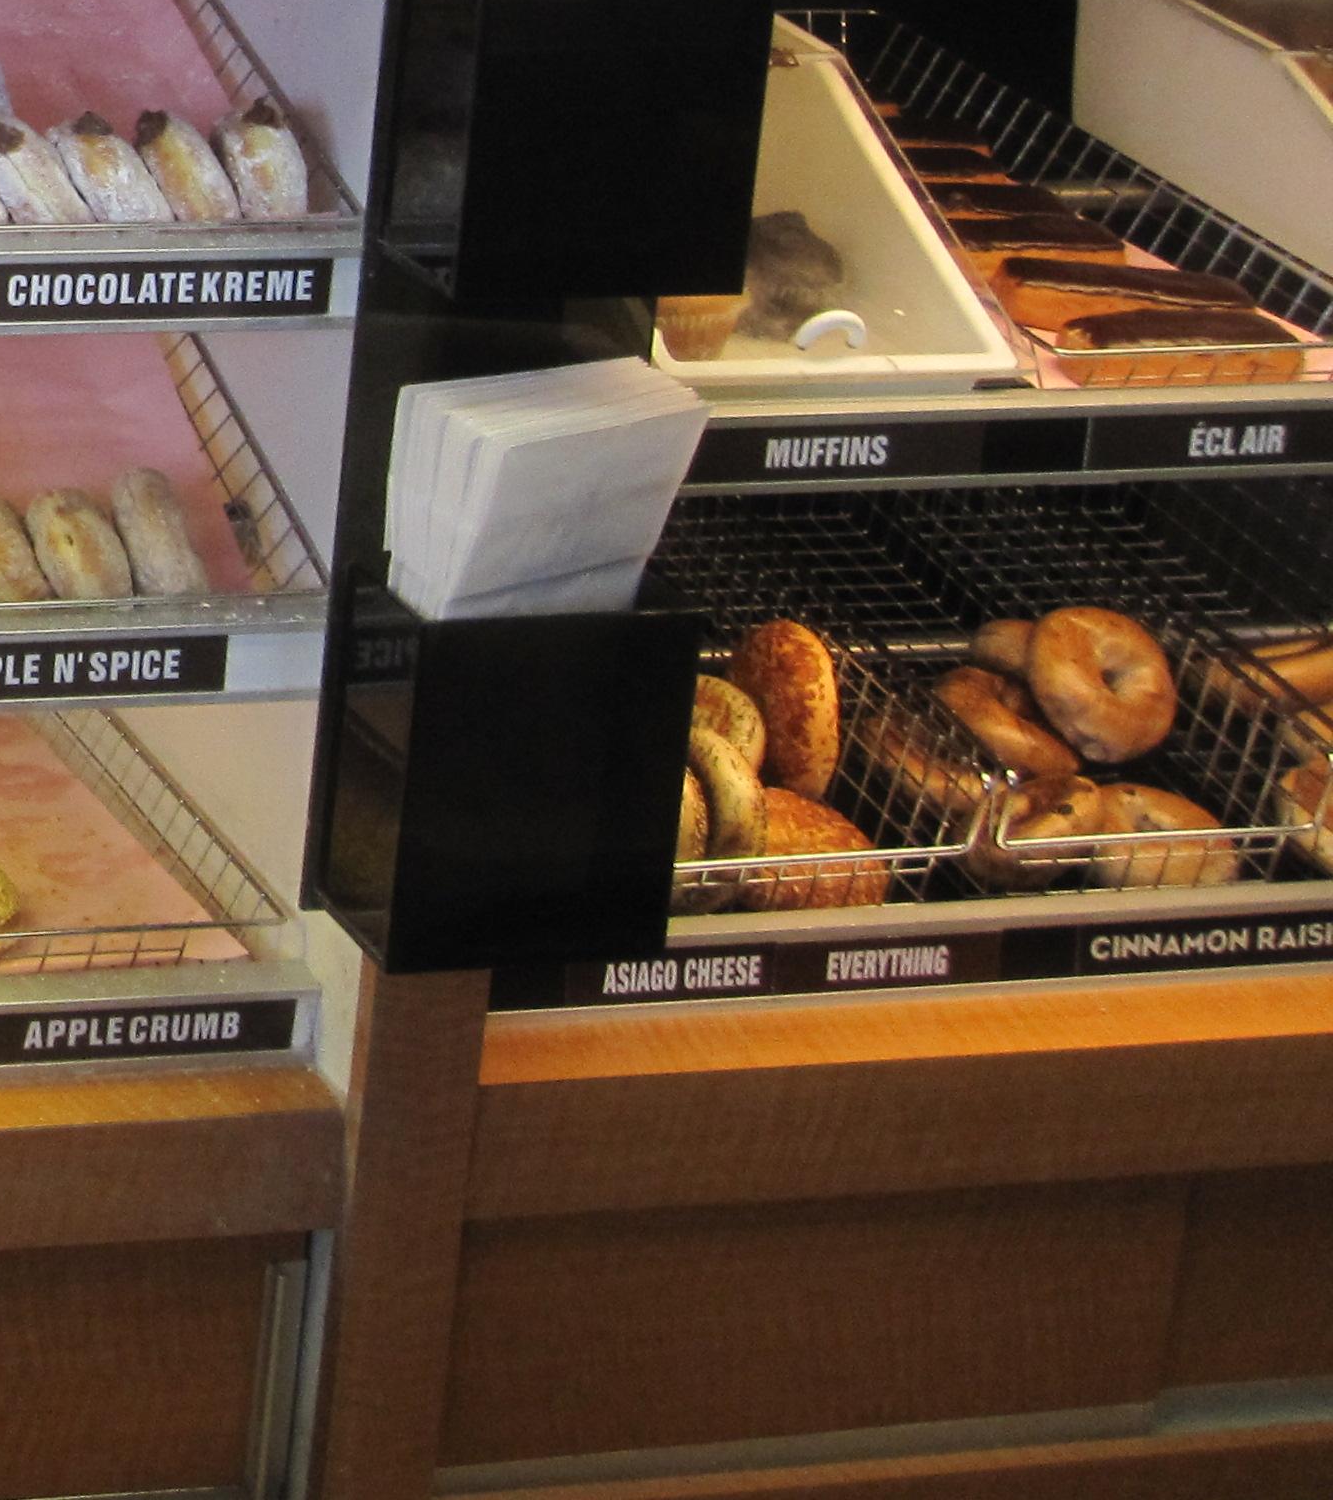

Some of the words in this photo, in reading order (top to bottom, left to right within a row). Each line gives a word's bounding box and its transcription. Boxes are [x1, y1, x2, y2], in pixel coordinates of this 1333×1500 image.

[7, 271, 196, 307] CHOCOLATE
[200, 269, 314, 303] KREME
[764, 434, 889, 468] MUFFINS
[1090, 927, 1249, 961] CINNAMON
[602, 959, 678, 995] ASIAGO
[683, 955, 761, 990] CHEESE
[826, 945, 949, 981] EVERYTHING
[23, 1016, 125, 1050] APPLE
[128, 1011, 241, 1045] CRUMB
